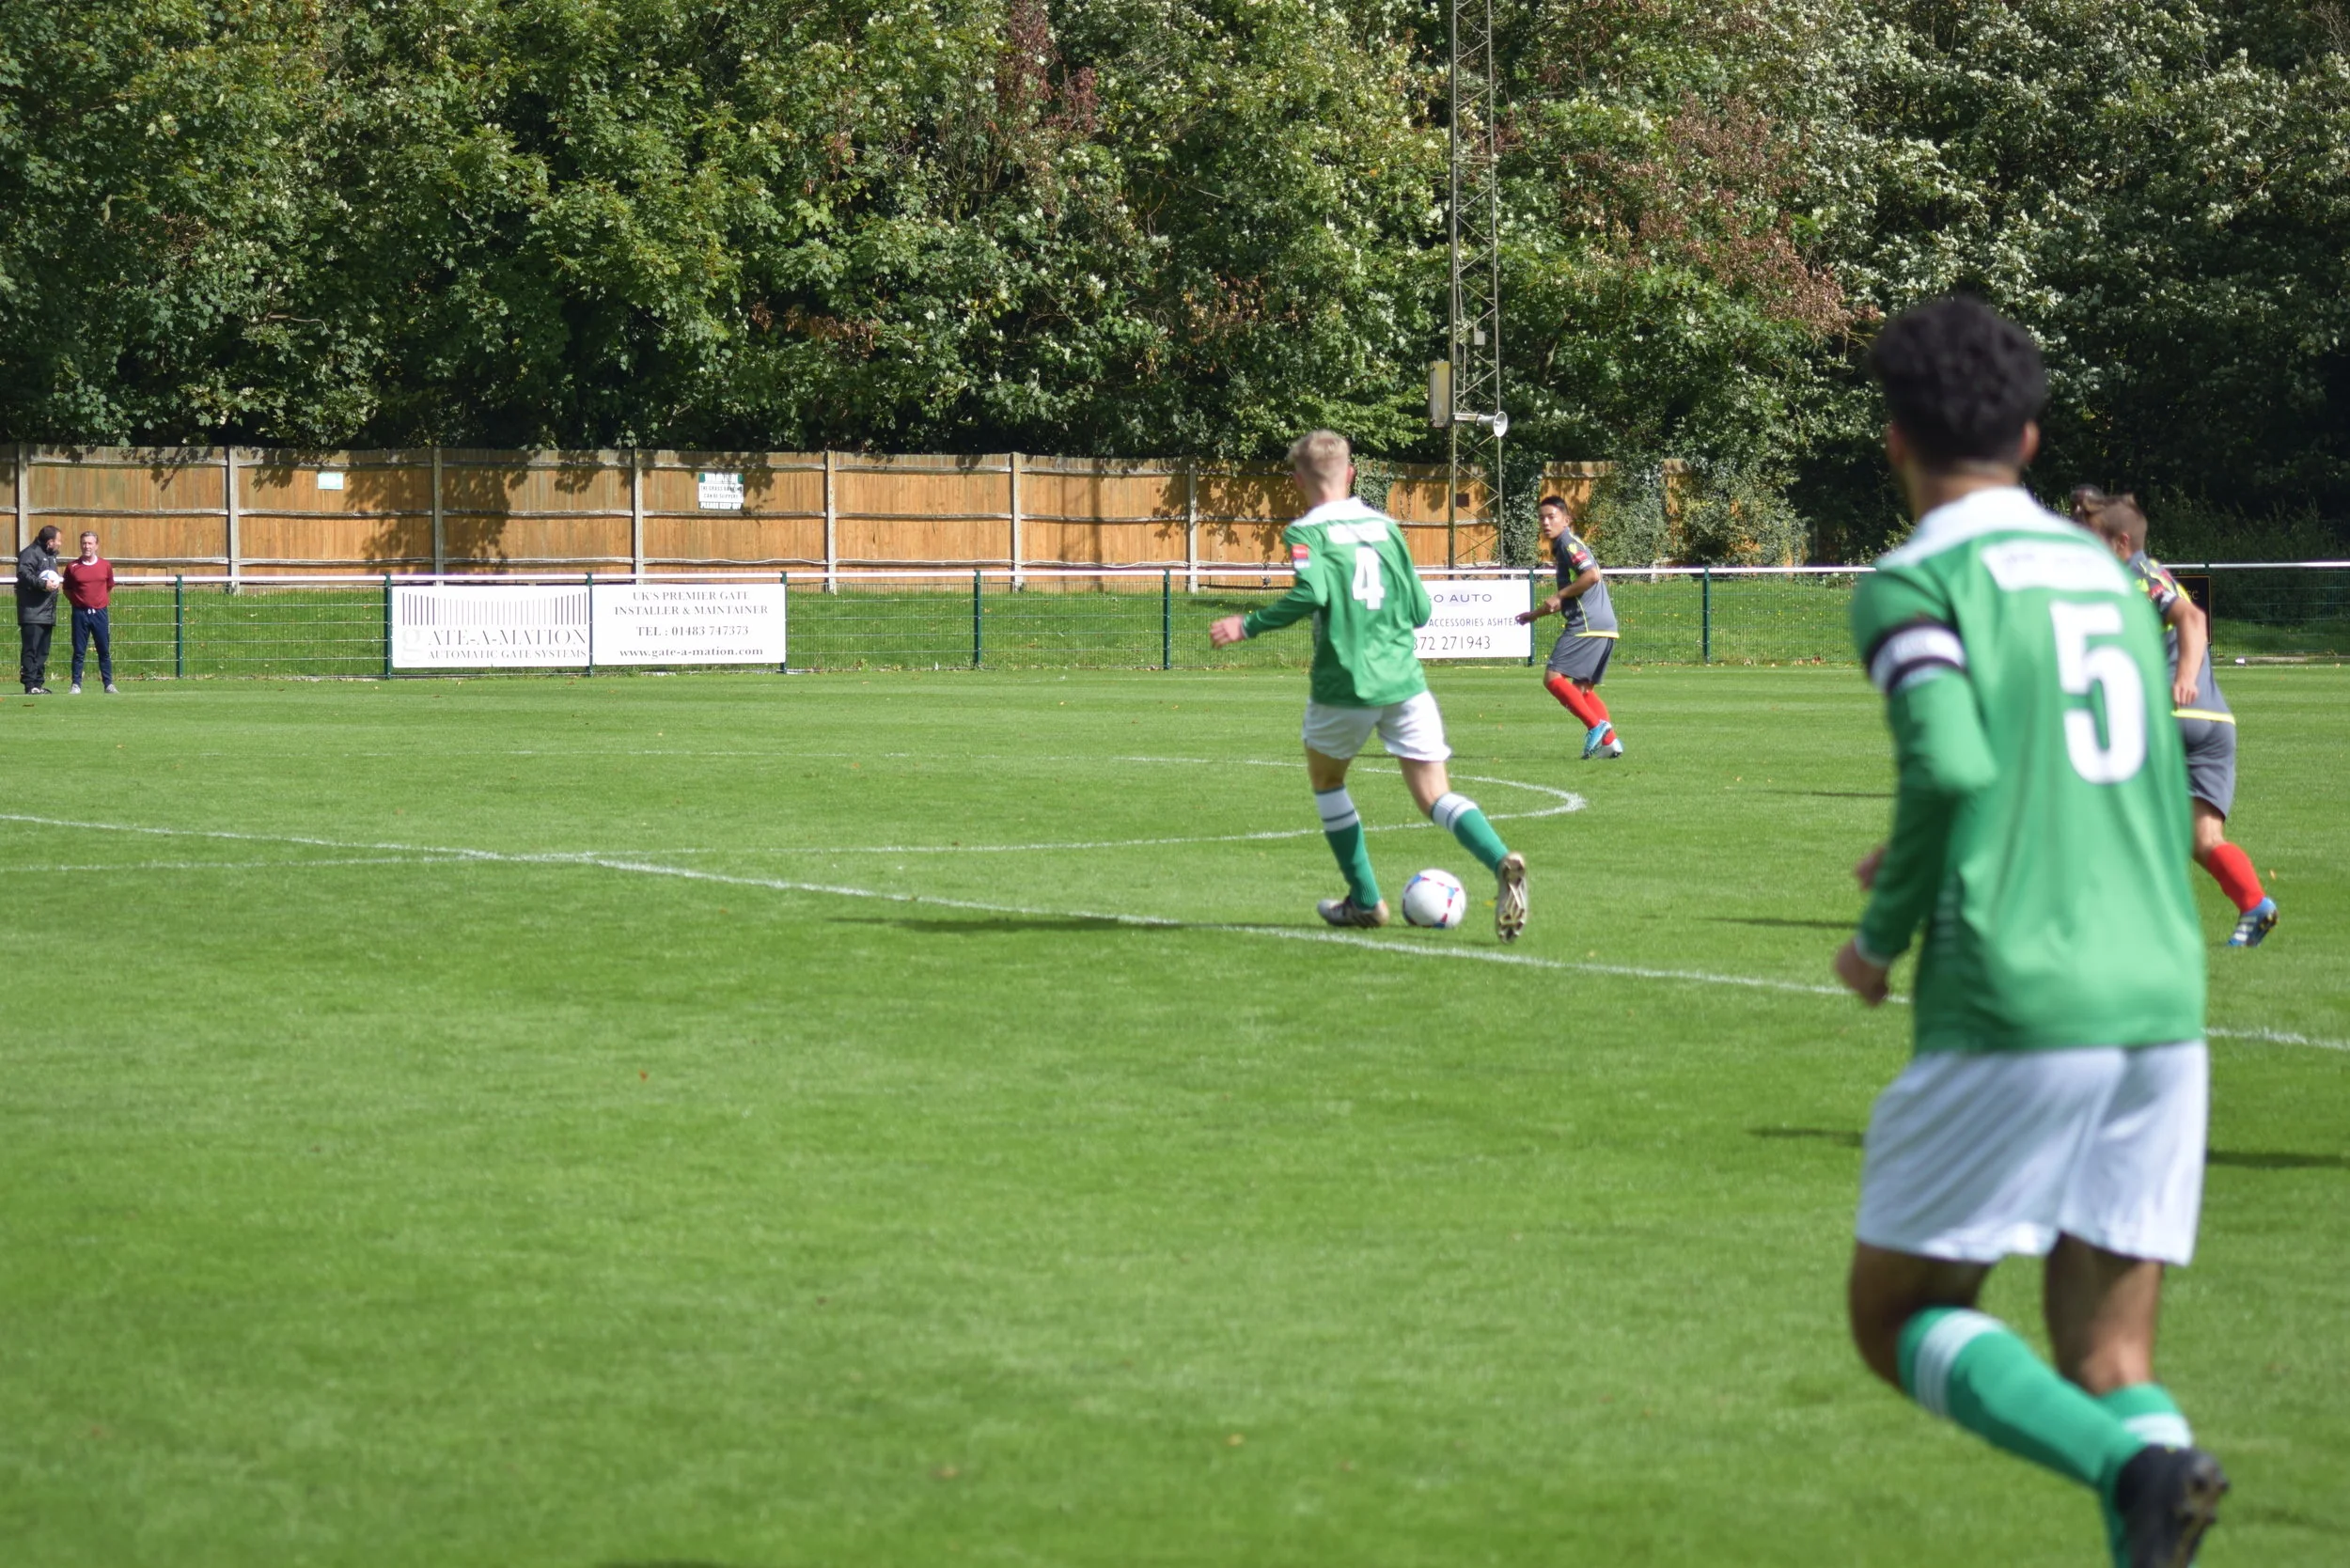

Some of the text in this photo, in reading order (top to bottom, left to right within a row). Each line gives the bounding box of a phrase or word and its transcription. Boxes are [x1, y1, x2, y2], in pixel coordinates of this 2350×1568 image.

[1352, 546, 1386, 610] 4
[633, 590, 749, 601] UK'S PREMIER GATE
[1427, 593, 1493, 603] O AUTO
[614, 605, 679, 616] INSTALLER
[694, 604, 768, 615] MAINTAINER
[1428, 617, 1519, 627] ACCESSORIES ASHTEA
[671, 625, 705, 636] 01483
[709, 625, 749, 635] 747373
[1442, 635, 1491, 651] 271943
[427, 649, 587, 660] AUTOMATIC GATE SYSTEMS
[619, 646, 763, 660] www.gate-a-mation.com
[2049, 599, 2147, 784] 5
